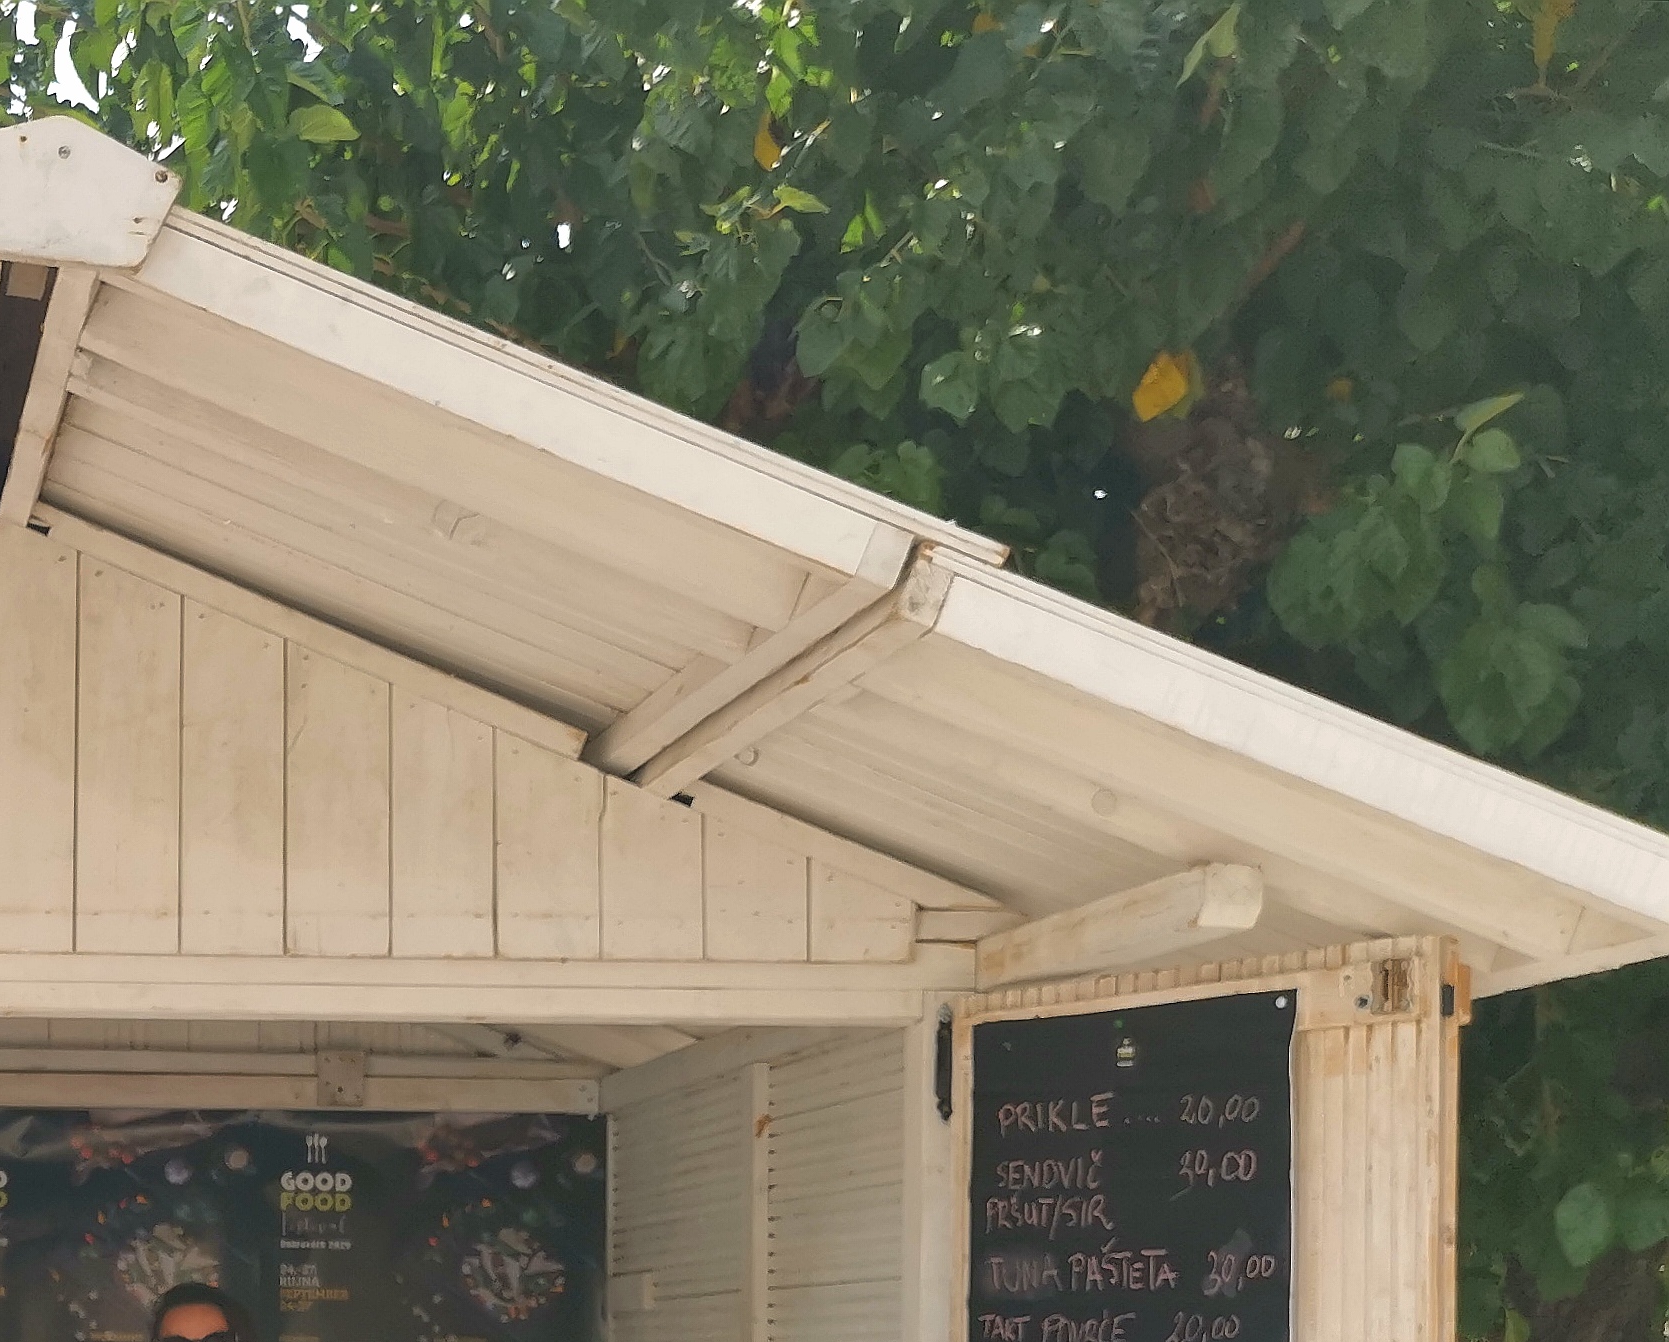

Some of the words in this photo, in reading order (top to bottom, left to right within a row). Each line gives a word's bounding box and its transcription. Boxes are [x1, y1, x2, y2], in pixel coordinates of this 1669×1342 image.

[997, 1091, 1115, 1138] PRIKLE
[1179, 1094, 1260, 1129] 20,00
[280, 1171, 353, 1192] GOOD
[280, 1191, 353, 1212] FOOD
[985, 1252, 1064, 1292] TUNA
